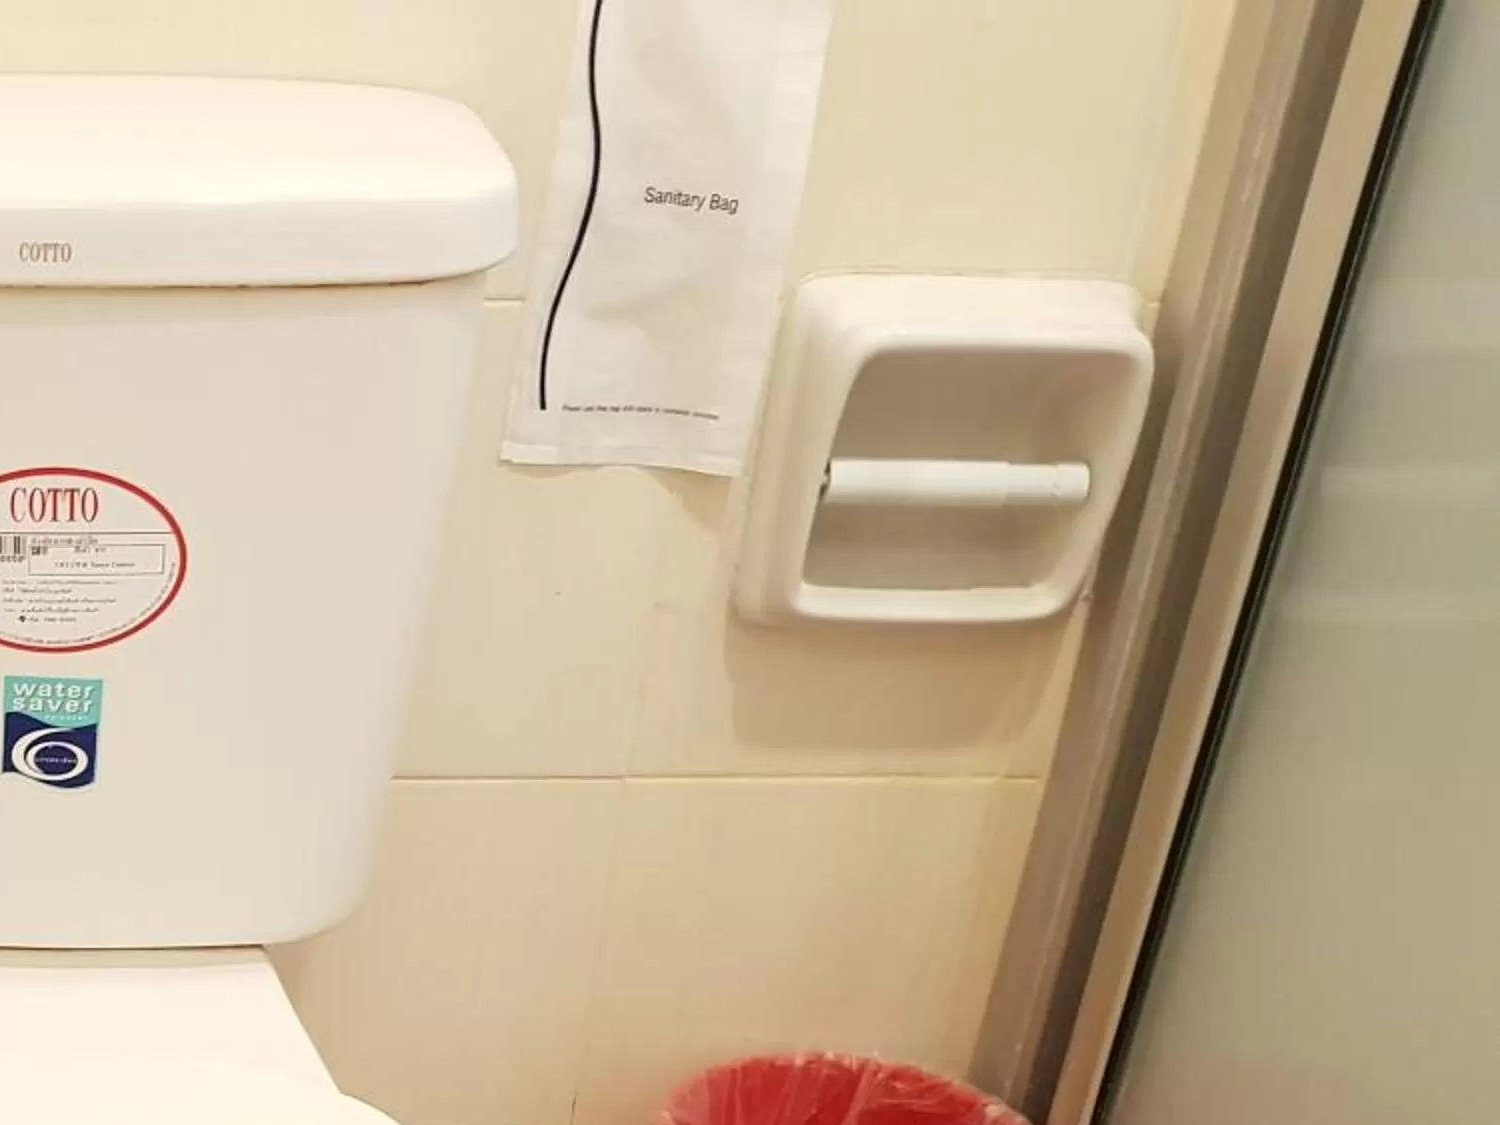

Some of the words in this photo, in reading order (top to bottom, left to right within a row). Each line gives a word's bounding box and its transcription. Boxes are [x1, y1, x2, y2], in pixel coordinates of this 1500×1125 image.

[643, 186, 706, 212] Sanitary
[708, 193, 739, 215] Bag
[19, 241, 72, 263] COTTO
[10, 487, 99, 522] COTTO
[13, 682, 94, 699] water
[12, 697, 93, 713] saver
